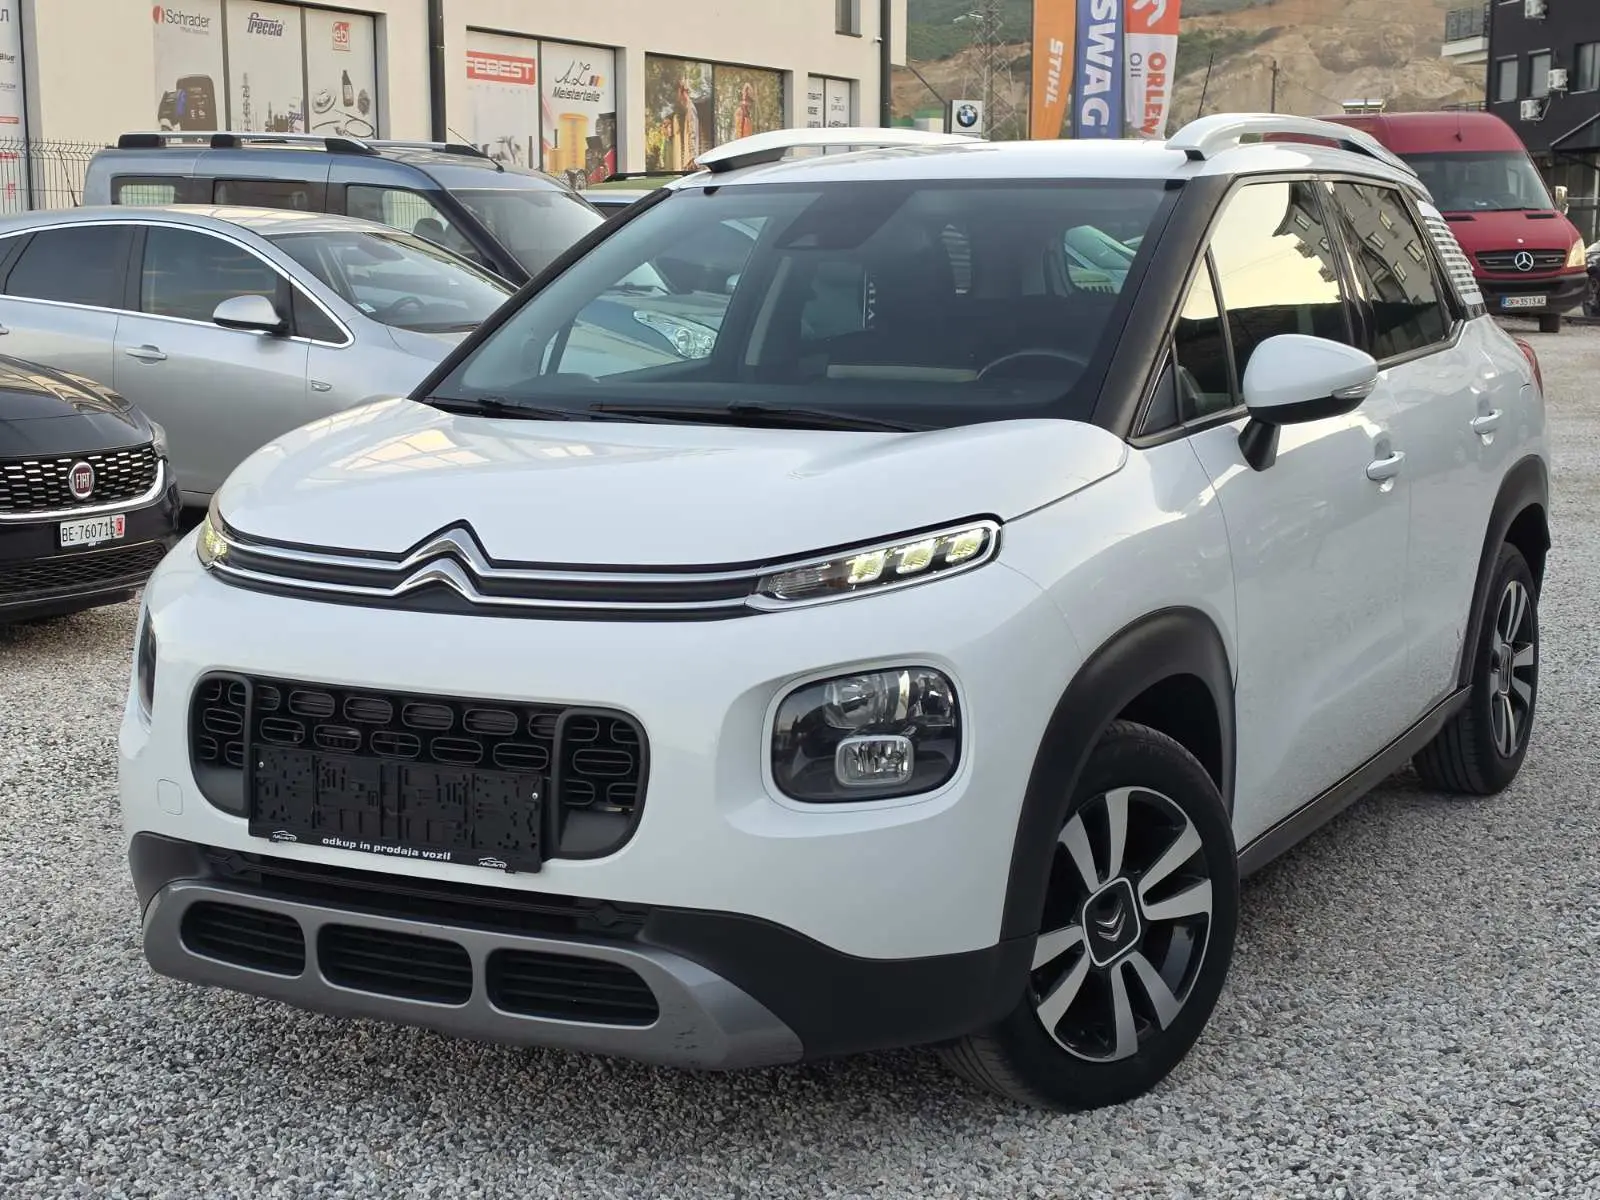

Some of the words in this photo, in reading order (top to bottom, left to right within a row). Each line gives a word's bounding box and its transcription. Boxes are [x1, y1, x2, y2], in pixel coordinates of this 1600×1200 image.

[165, 9, 211, 28] Schrader
[247, 12, 284, 37] freccia
[1044, 38, 1064, 107] STIHL
[1081, 0, 1117, 126] SWAG
[552, 86, 601, 102] Meisterteile
[1139, 52, 1167, 136] ORLEN
[75, 472, 91, 489] FIAT
[322, 837, 357, 849] odkup
[360, 841, 371, 850] in
[373, 844, 419, 857] prodaja
[422, 850, 451, 861] vozil
